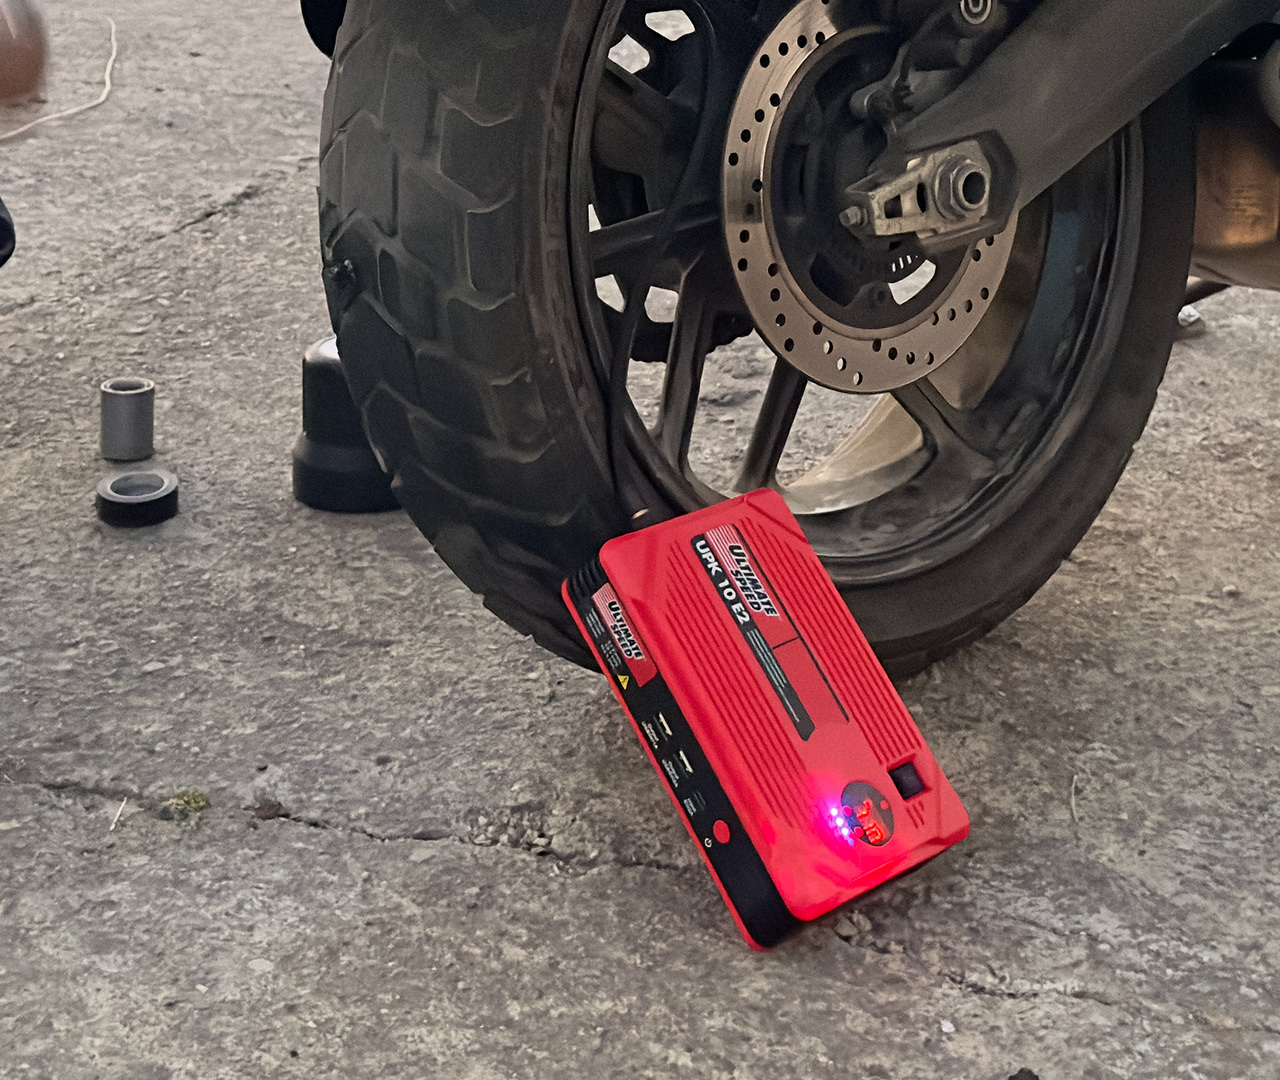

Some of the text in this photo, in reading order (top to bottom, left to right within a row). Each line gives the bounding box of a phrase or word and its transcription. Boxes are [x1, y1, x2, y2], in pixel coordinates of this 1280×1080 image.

[695, 540, 751, 625] UPK 10 E2
[728, 544, 779, 616] ULTIMATE
[730, 569, 762, 611] SPEED
[607, 600, 643, 658] ULTIMATE
[610, 623, 633, 657] SPEED
